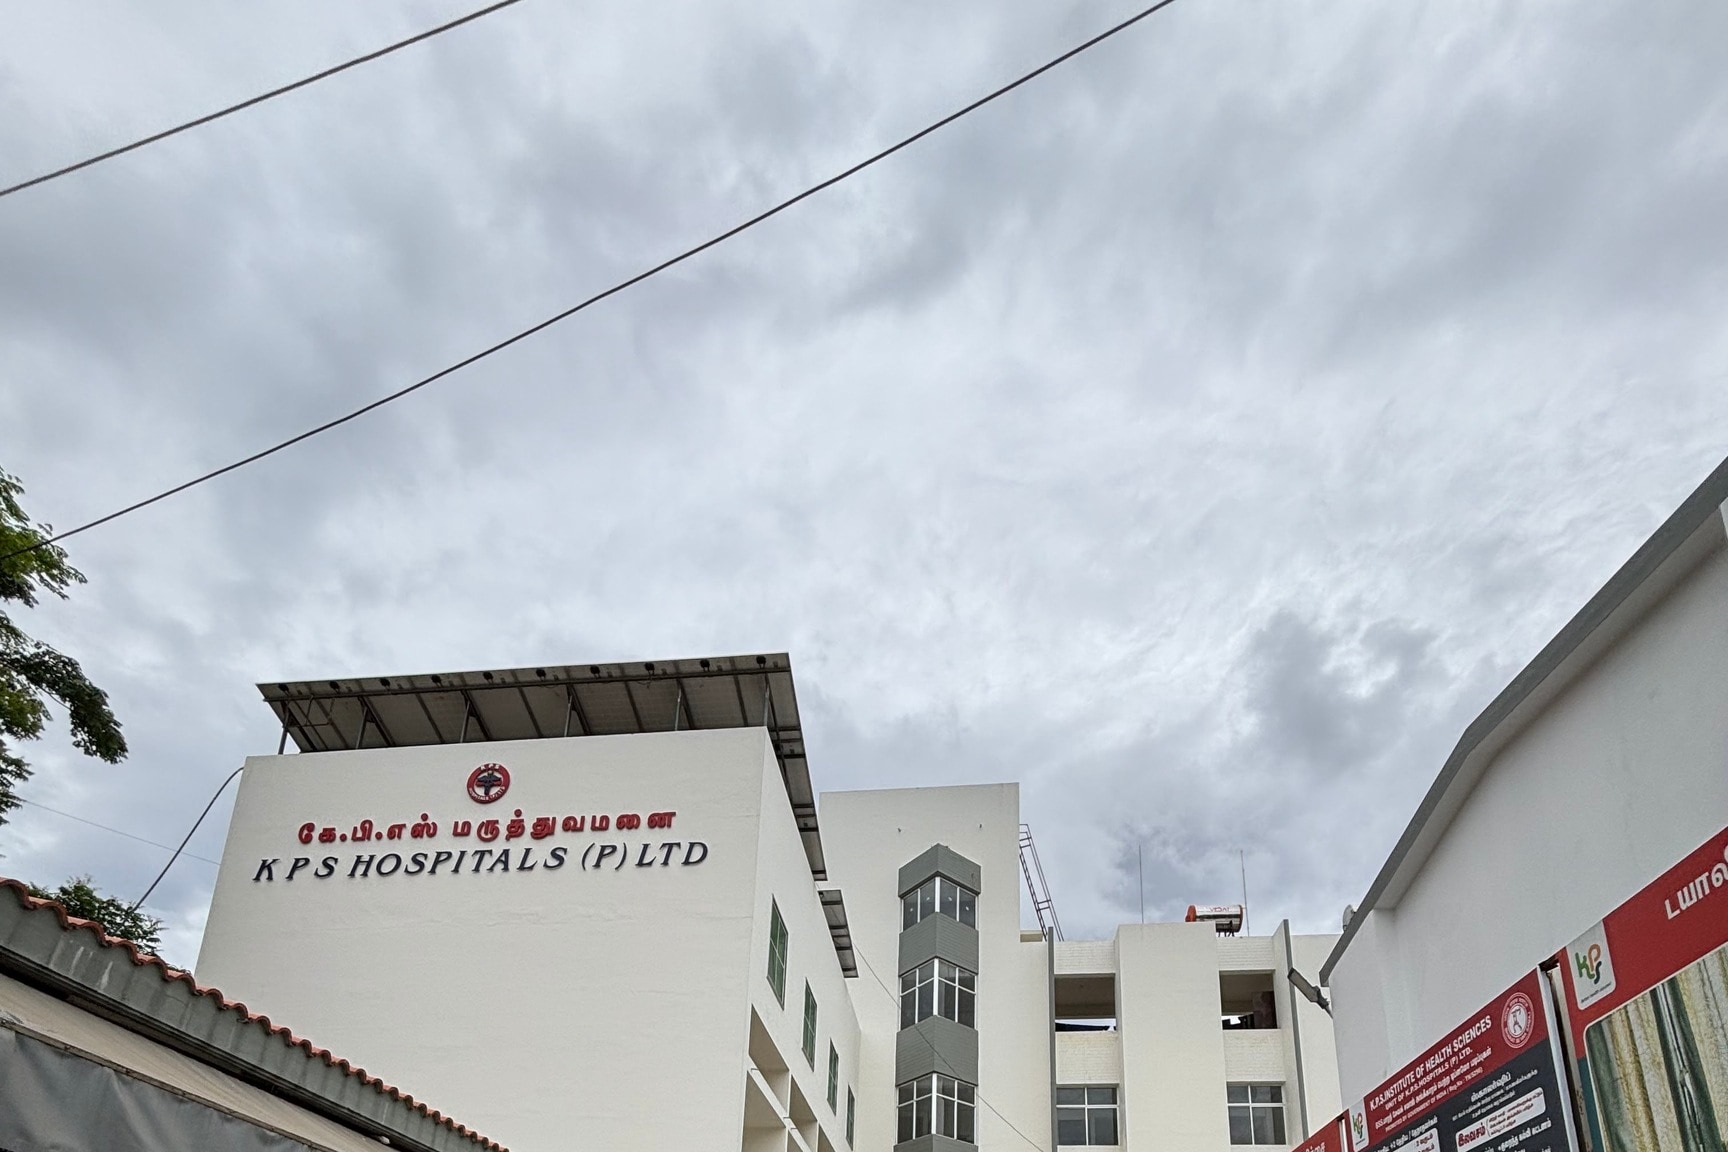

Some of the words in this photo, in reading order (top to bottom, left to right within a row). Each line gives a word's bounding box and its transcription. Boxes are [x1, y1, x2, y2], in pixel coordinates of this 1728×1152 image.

[298, 813, 438, 845] கே.பி.எஸ்
[452, 809, 677, 843] மருத்துவமனை
[347, 845, 568, 878] HOSPITALS
[581, 842, 628, 871] (P)
[634, 841, 709, 868] LTD
[1415, 1063, 1424, 1078] OF
[1425, 1044, 1452, 1071] HEALTH
[1453, 1015, 1491, 1051] SCIENCES
[1397, 1092, 1404, 1101] OF
[1458, 1122, 1485, 1146] இலவசம்
